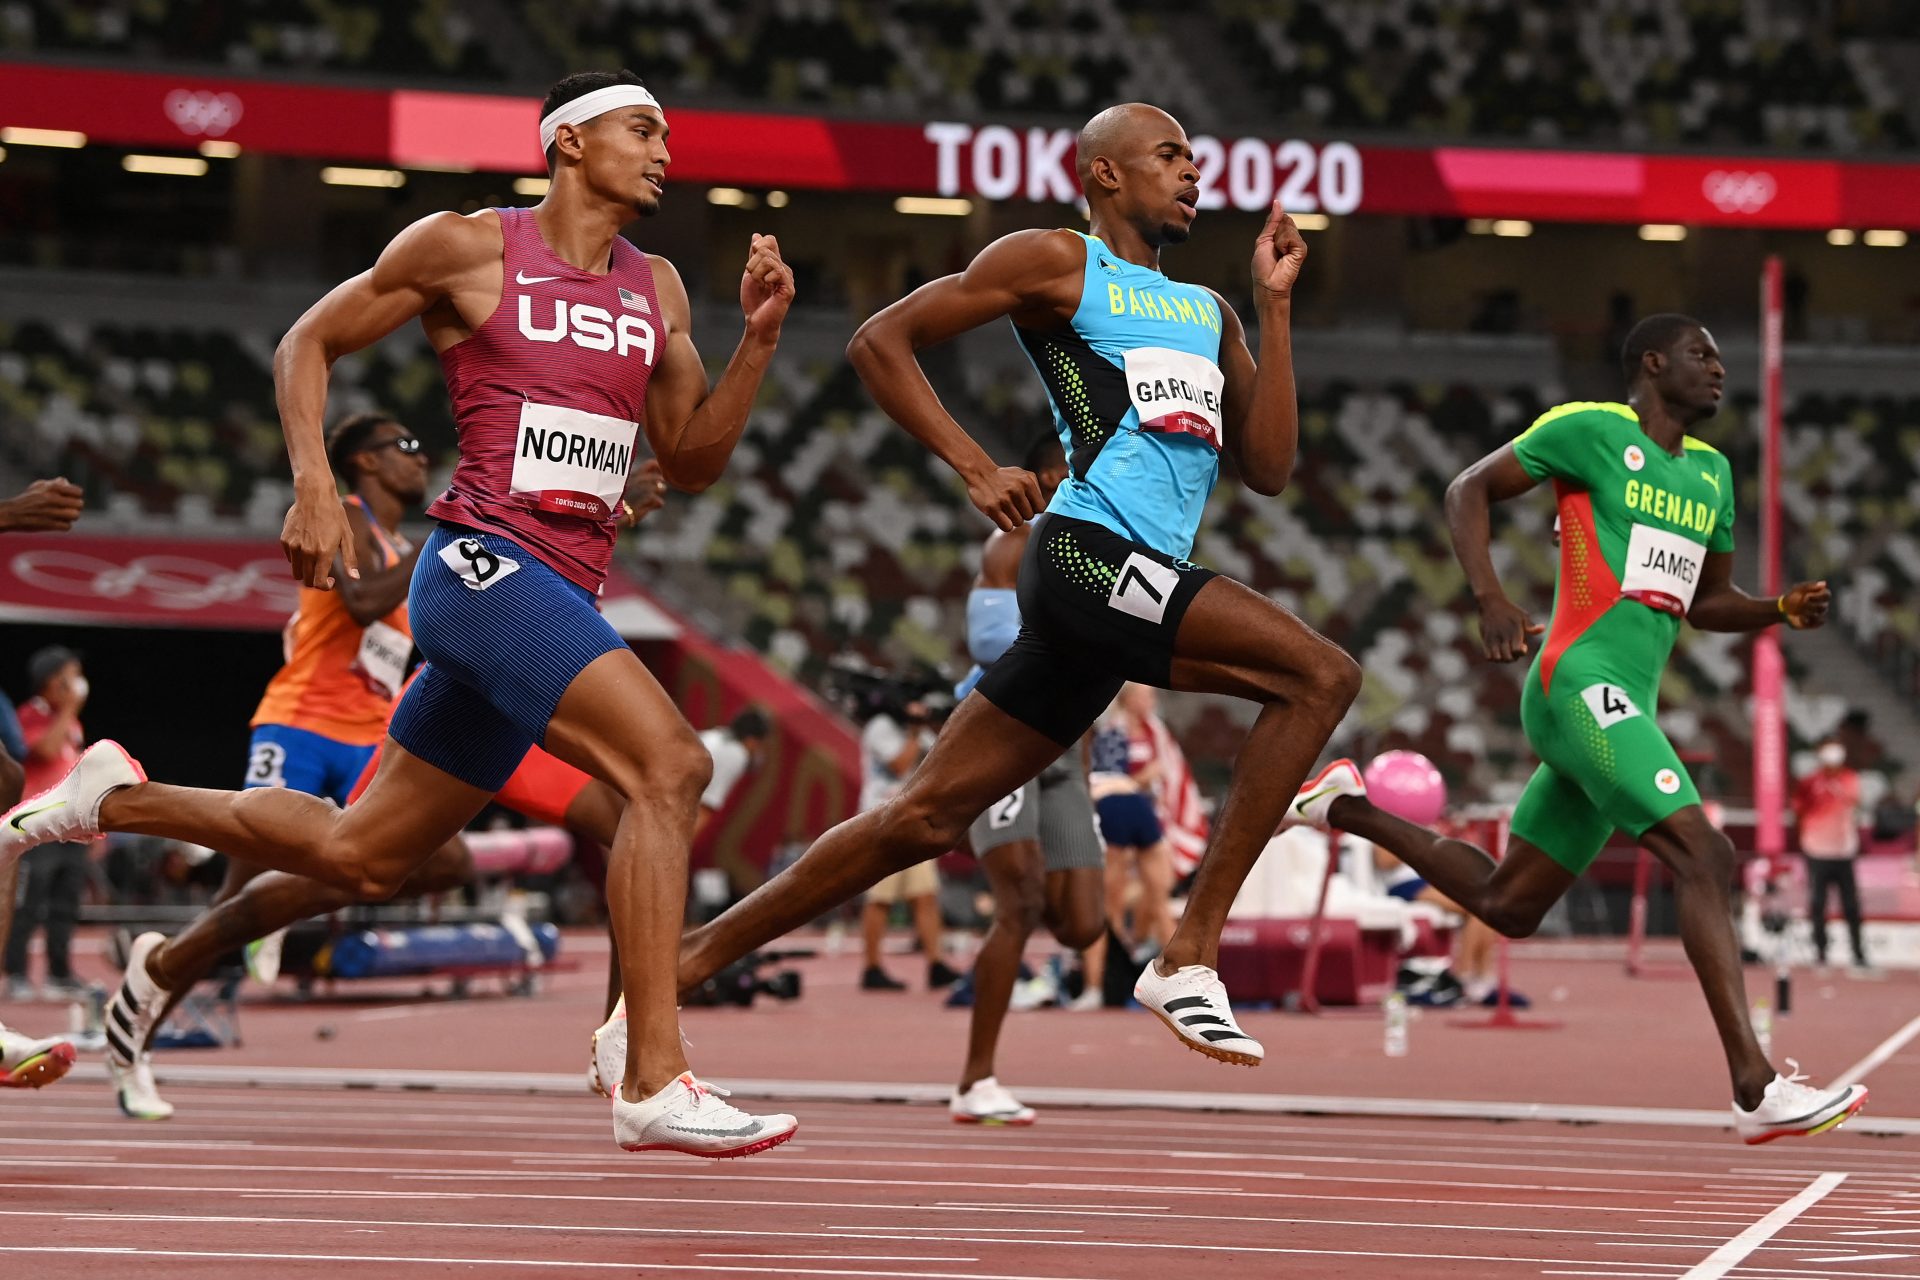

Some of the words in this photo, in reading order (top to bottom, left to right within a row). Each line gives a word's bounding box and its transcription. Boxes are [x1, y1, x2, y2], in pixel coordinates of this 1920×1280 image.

[924, 121, 1081, 203] TOK
[1194, 136, 1363, 215] 2020
[1107, 282, 1219, 335] BAHAMAS
[518, 294, 656, 367] USA
[522, 426, 630, 477] NORMAN
[555, 497, 574, 508] TOKYO
[1624, 478, 1717, 537] GRENADA
[459, 540, 500, 582] 8
[1641, 546, 1697, 584] JAMES
[1117, 564, 1163, 606] 7
[1603, 686, 1627, 715] 4
[254, 748, 276, 779] 3
[998, 793, 1017, 821] 2
